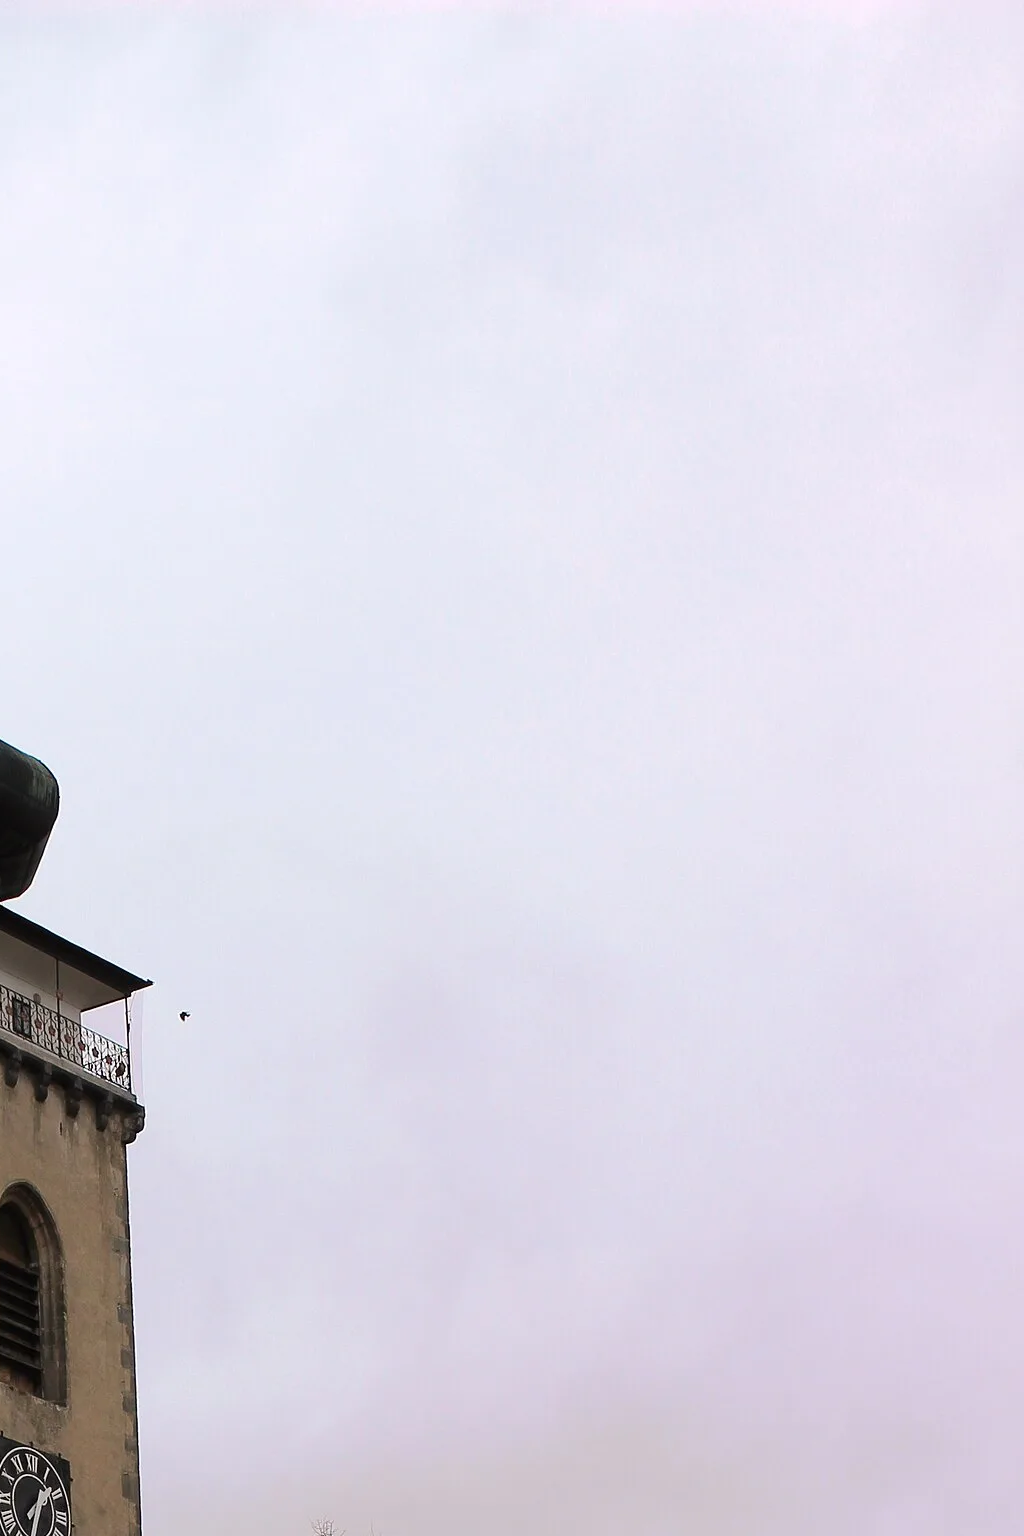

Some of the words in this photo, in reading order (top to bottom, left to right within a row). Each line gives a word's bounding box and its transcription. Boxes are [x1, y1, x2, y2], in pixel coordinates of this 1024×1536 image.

[10, 1453, 24, 1475] XI
[25, 1453, 38, 1473] XII
[1, 1467, 15, 1485] X
[44, 1466, 50, 1482] I
[51, 1487, 63, 1500] II
[1, 1509, 16, 1534] VIII
[56, 1510, 67, 1527] III
